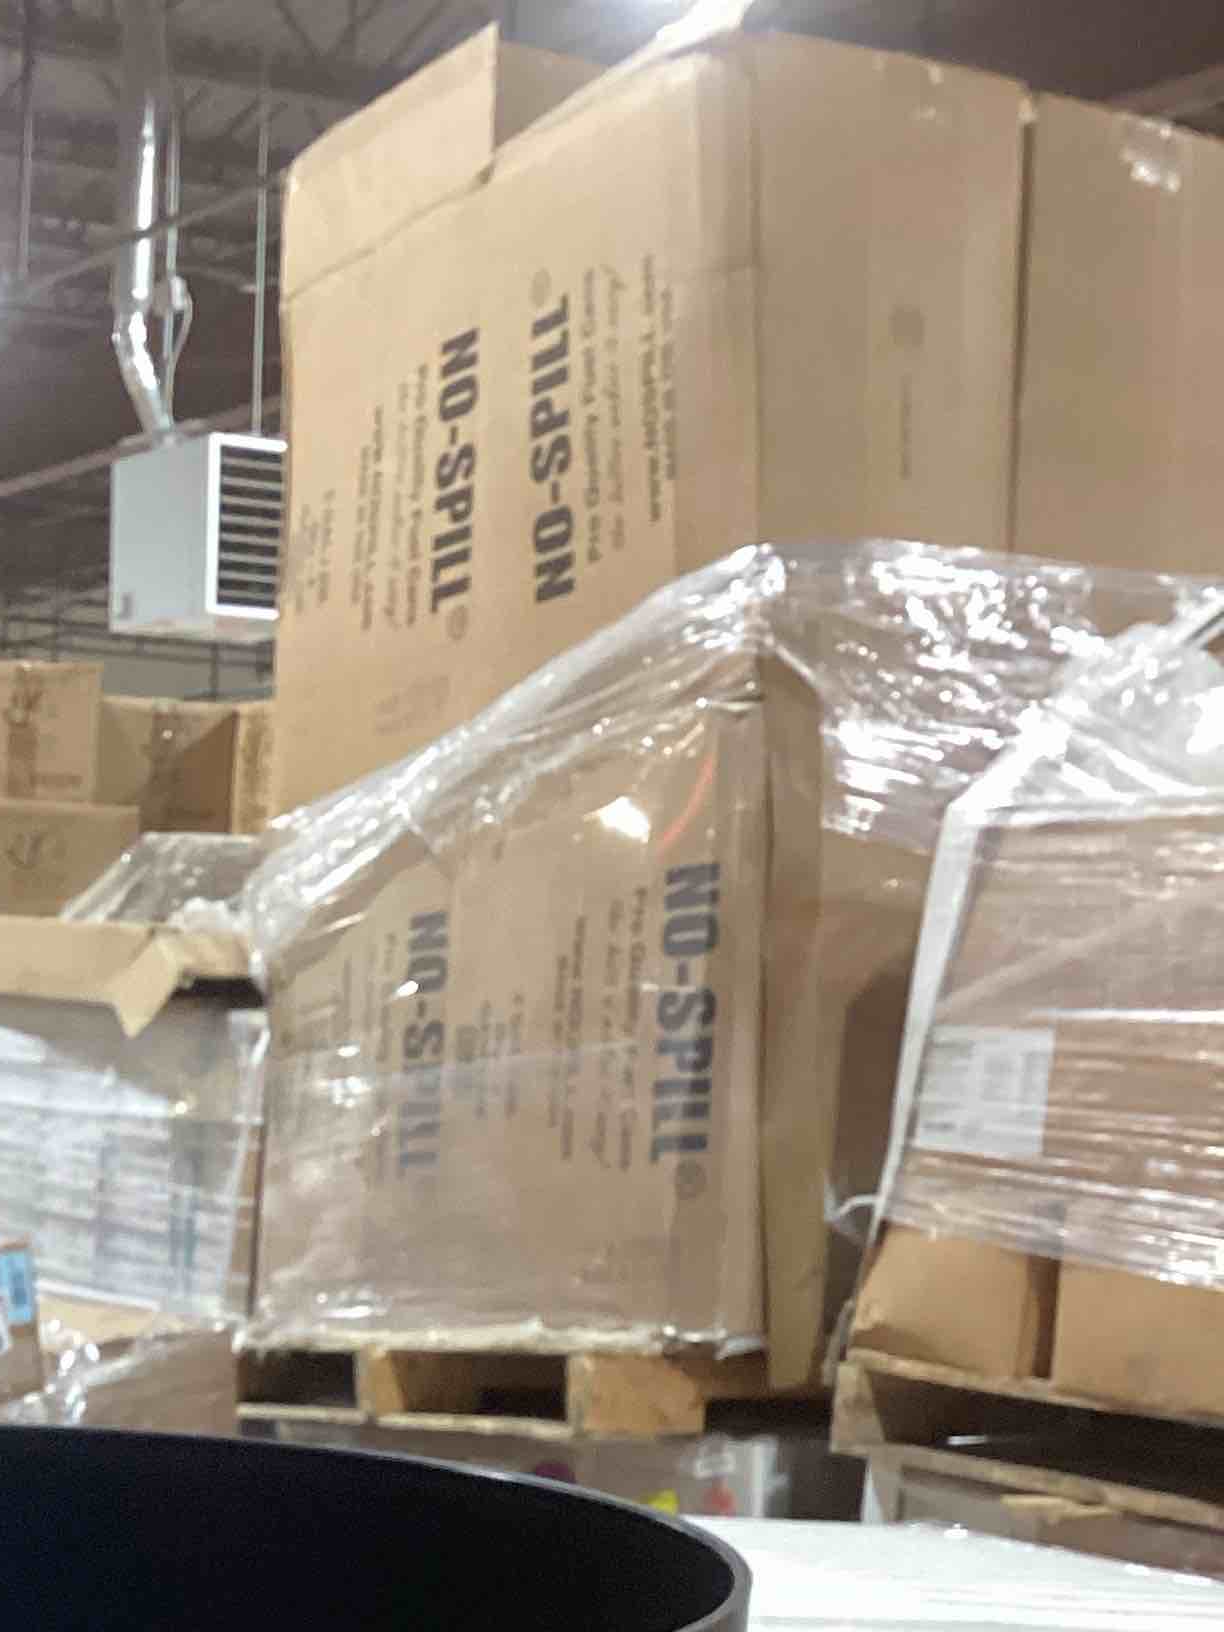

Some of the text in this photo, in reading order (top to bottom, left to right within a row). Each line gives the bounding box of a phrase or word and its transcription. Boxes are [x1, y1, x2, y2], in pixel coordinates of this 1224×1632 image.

[431, 327, 480, 613] NO-SPILL
[530, 292, 575, 603] NO-SPILL
[650, 862, 720, 1166] NO-SPILL
